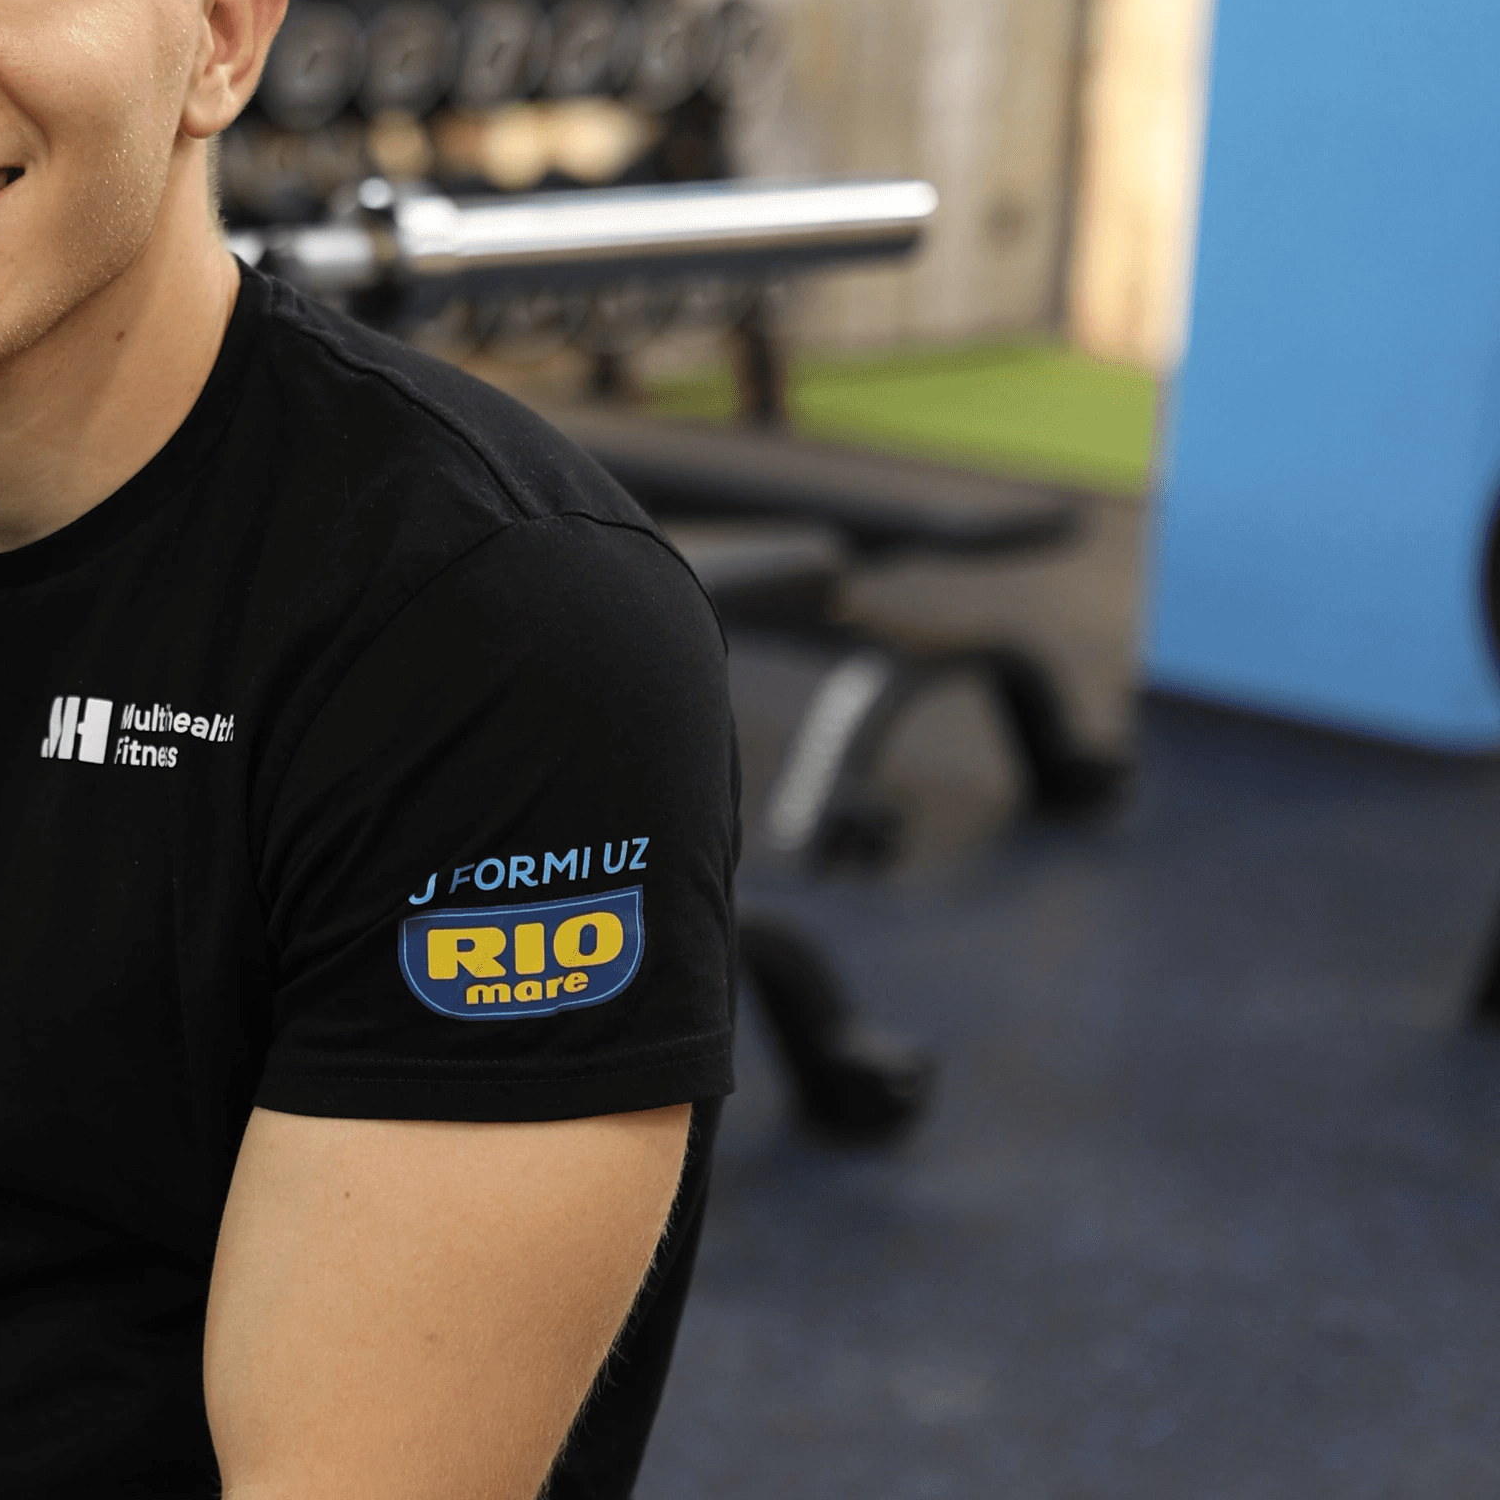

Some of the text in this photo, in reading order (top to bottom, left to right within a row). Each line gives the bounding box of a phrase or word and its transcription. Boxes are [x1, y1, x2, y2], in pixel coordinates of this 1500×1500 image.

[449, 847, 592, 894] FORMI
[603, 837, 650, 875] UZ
[427, 911, 624, 980] RIO
[466, 971, 590, 1005] mare
